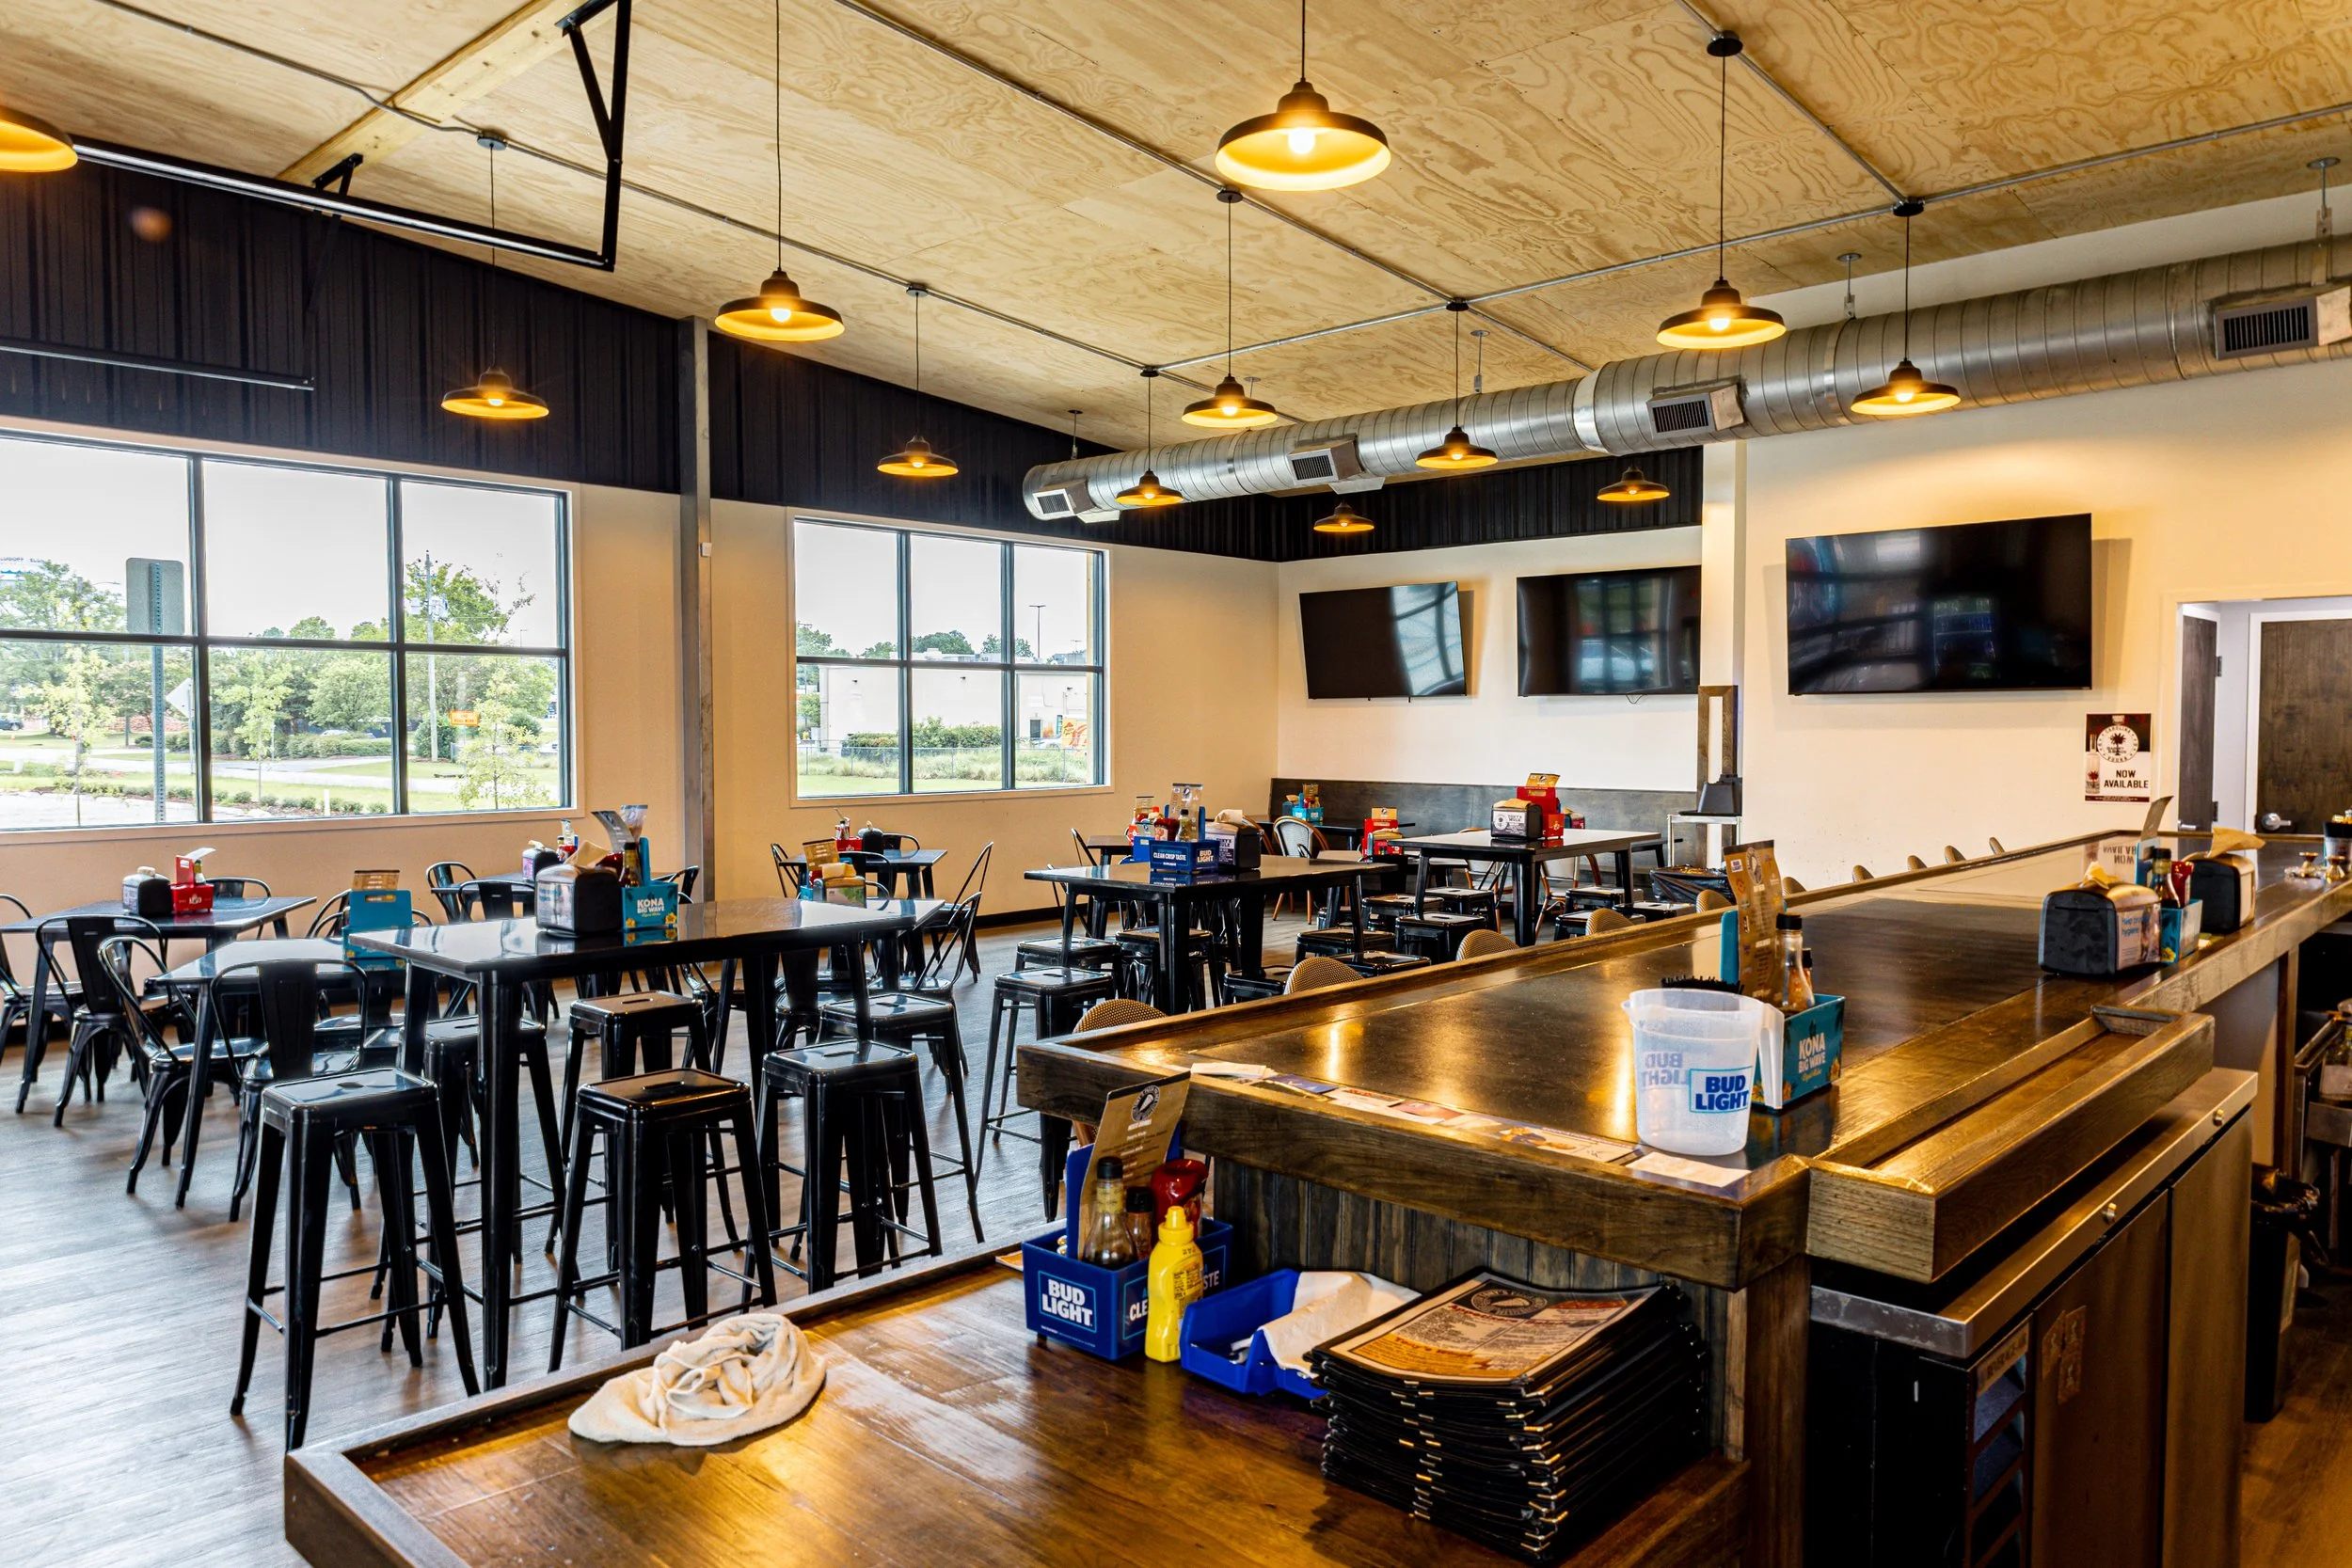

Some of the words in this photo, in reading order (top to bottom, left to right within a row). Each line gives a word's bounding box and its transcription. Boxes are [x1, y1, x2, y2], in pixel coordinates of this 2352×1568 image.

[2116, 769, 2137, 778] NOW
[2104, 780, 2149, 788] AVAILABLE
[637, 897, 664, 907] KONA
[1799, 1032, 1826, 1061] KONA
[1798, 1058, 1809, 1073] BIG
[1809, 1052, 1827, 1069] WAVE
[1705, 1074, 1746, 1093] BUD
[1695, 1090, 1750, 1110] LIGHT
[1047, 1278, 1086, 1307] BUD
[1129, 1299, 1149, 1322] CLE
[1202, 1270, 1220, 1291] STE
[1041, 1292, 1093, 1327] LIGHT
